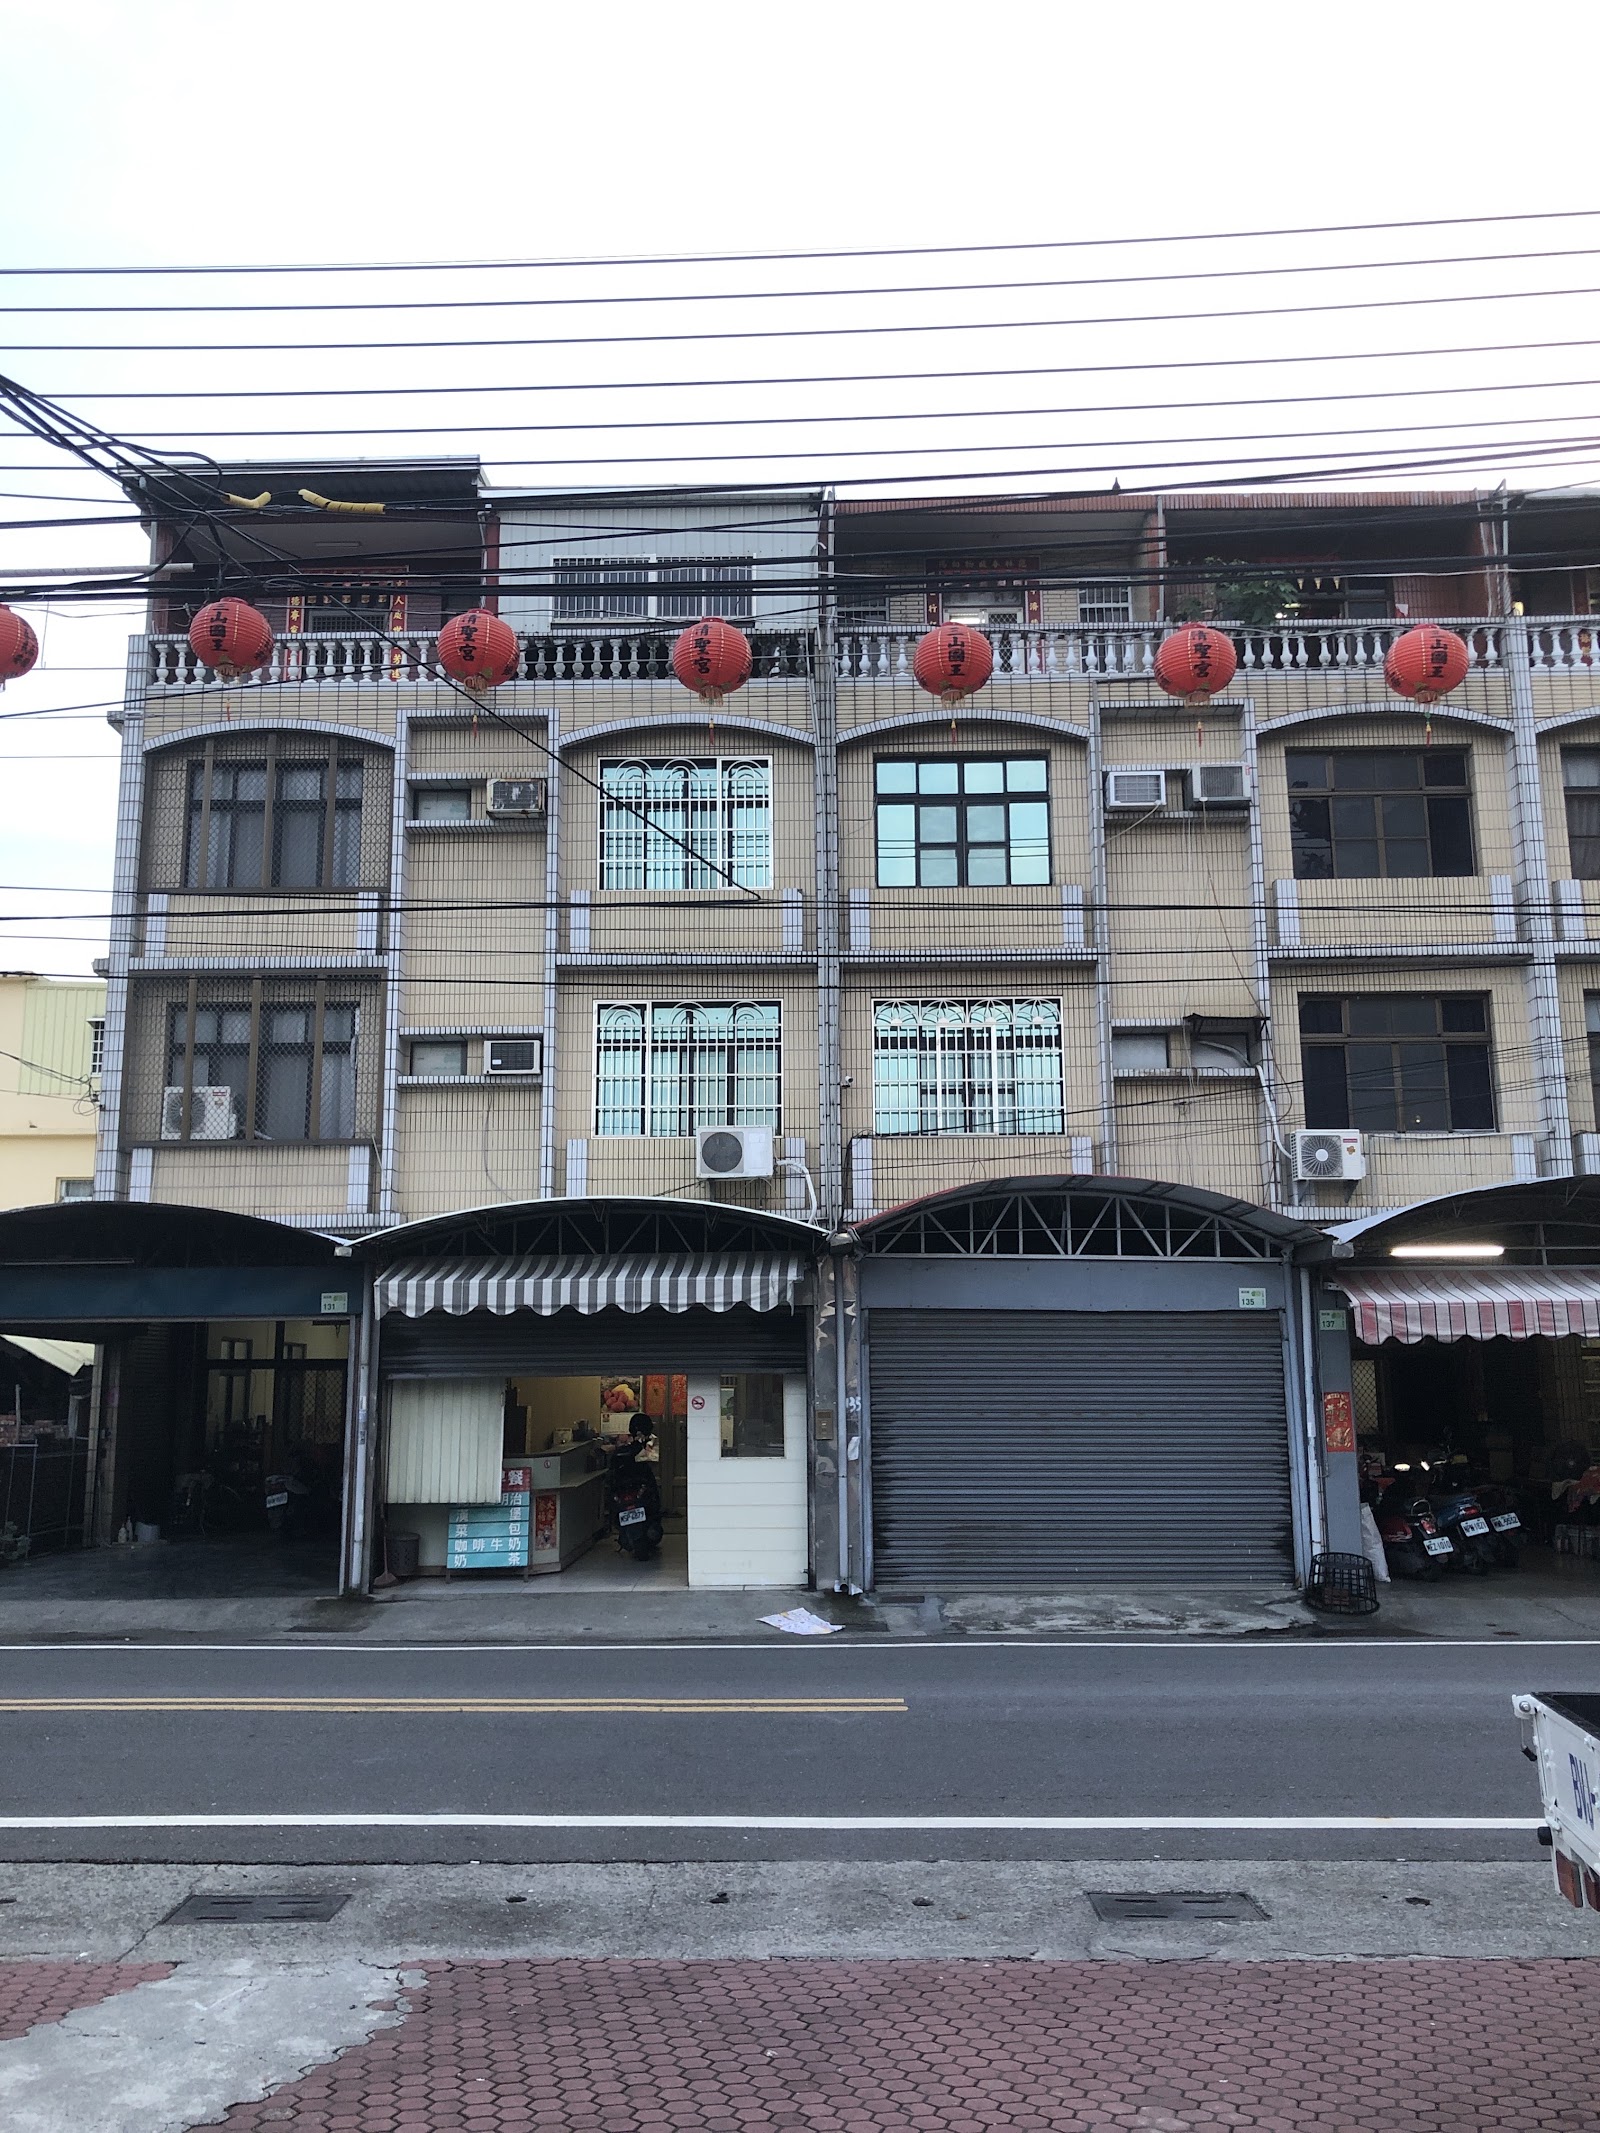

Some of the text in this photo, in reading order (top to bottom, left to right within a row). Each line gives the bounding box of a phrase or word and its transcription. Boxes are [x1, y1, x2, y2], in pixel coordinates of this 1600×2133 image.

[209, 602, 229, 652] 三山國王
[947, 627, 966, 676] 三山國王
[1426, 630, 1448, 678] 三山國王
[323, 1303, 335, 1311] 131
[1241, 1298, 1255, 1306] 135
[1321, 1320, 1335, 1328] 137
[845, 1396, 862, 1413] 135
[502, 1469, 524, 1486] 餐
[455, 1522, 521, 1537] 菜包
[454, 1537, 521, 1552] 咖啡牛奶
[453, 1552, 521, 1568] 奶茶
